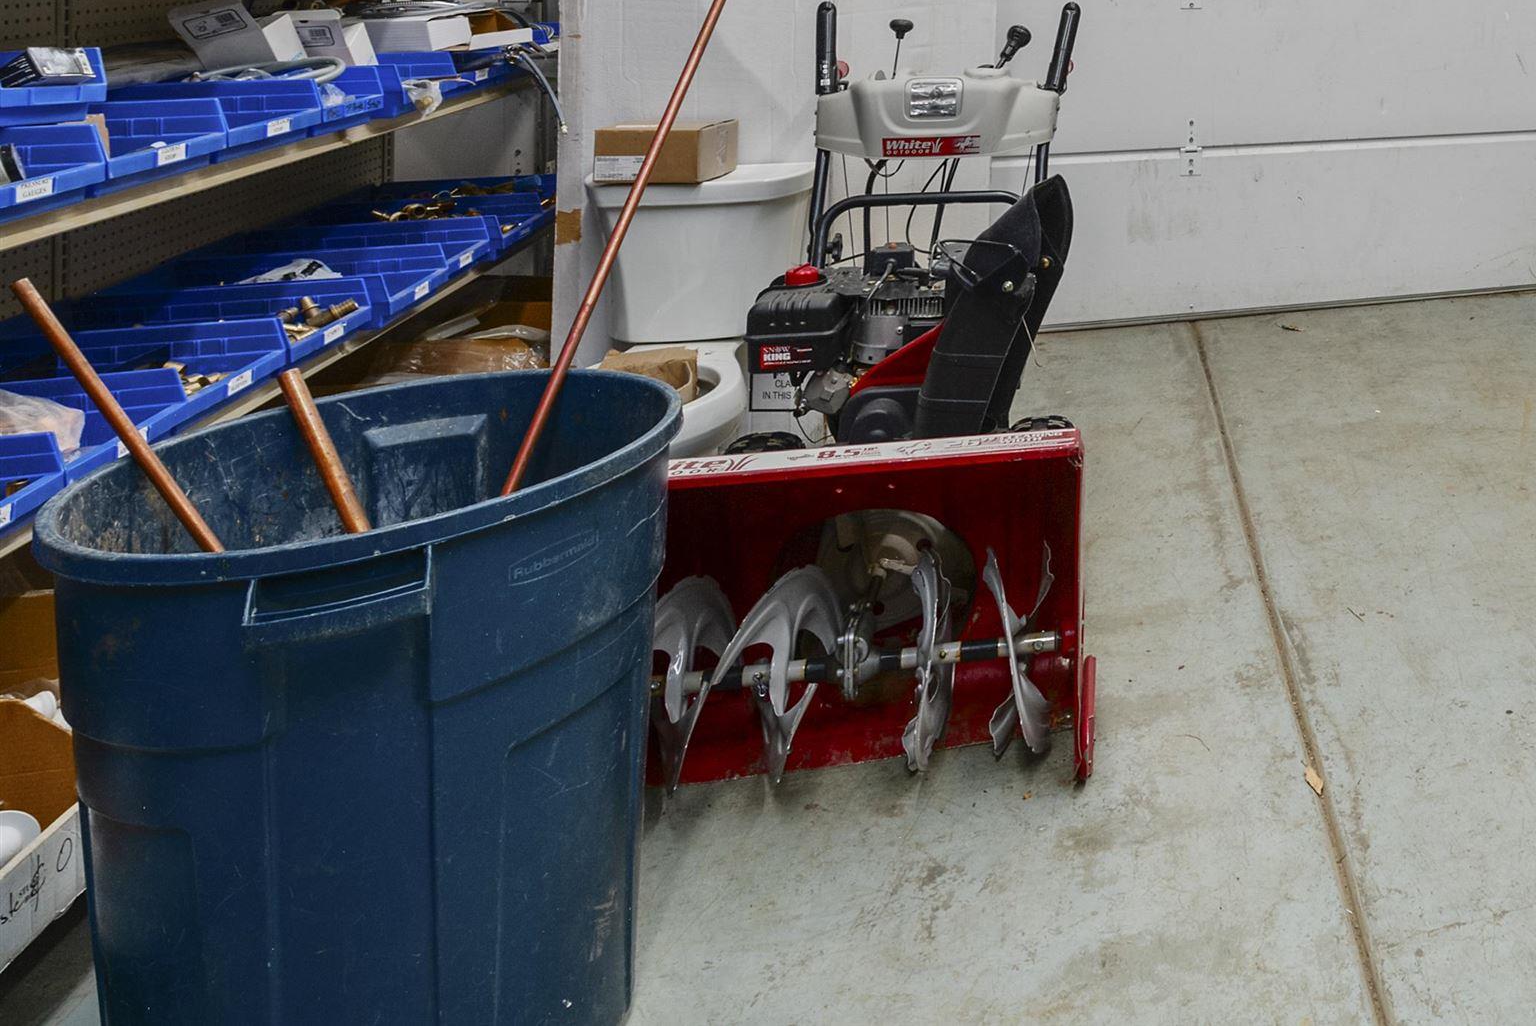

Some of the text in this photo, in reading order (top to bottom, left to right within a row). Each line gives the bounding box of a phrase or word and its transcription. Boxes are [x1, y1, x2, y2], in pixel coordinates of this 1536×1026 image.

[886, 140, 931, 150] White
[763, 346, 791, 354] SNOW
[763, 353, 791, 361] KING
[762, 390, 792, 401] IN THIS
[513, 535, 600, 580] Rubbermaid
